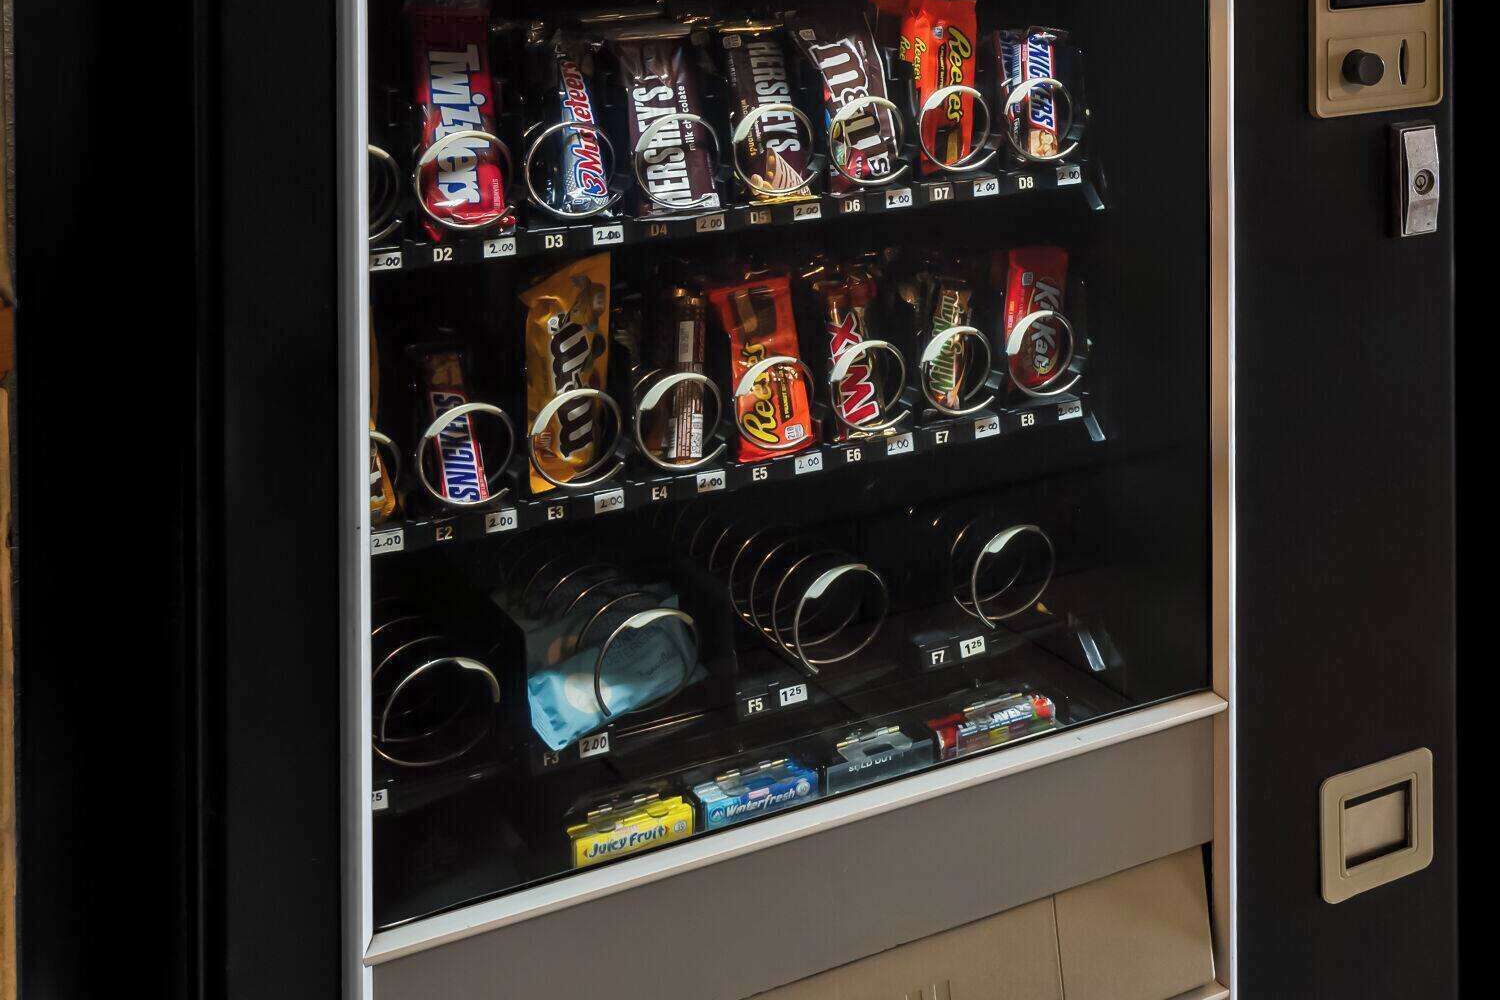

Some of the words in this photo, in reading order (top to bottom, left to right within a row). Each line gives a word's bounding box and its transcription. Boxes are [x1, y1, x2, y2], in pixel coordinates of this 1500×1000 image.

[632, 82, 693, 209] HERSHEY'S
[580, 169, 607, 197] 3
[1018, 177, 1034, 189] D8
[934, 187, 949, 200] D7
[844, 200, 861, 212] D6
[750, 211, 767, 223] D5
[650, 224, 668, 237] D4
[545, 235, 563, 249] D3
[596, 229, 621, 241] 2.00
[433, 248, 453, 262] D2
[490, 241, 514, 255] 2.00
[373, 256, 400, 267] 2.00
[1021, 413, 1035, 426] E8
[935, 430, 950, 443] E7
[846, 448, 861, 461] E6
[752, 467, 768, 480] E5
[652, 487, 668, 500] E4
[700, 476, 723, 488] 2.00
[547, 506, 564, 520] E3
[435, 527, 453, 541] E2
[488, 515, 513, 527] 2.00
[373, 535, 402, 548] 2.00
[931, 650, 945, 664] F7
[747, 698, 763, 713] F5
[582, 737, 607, 750] 2.00
[725, 787, 796, 818] Winterfresh
[587, 836, 627, 859] Juicy
[628, 826, 666, 848] Fruit
